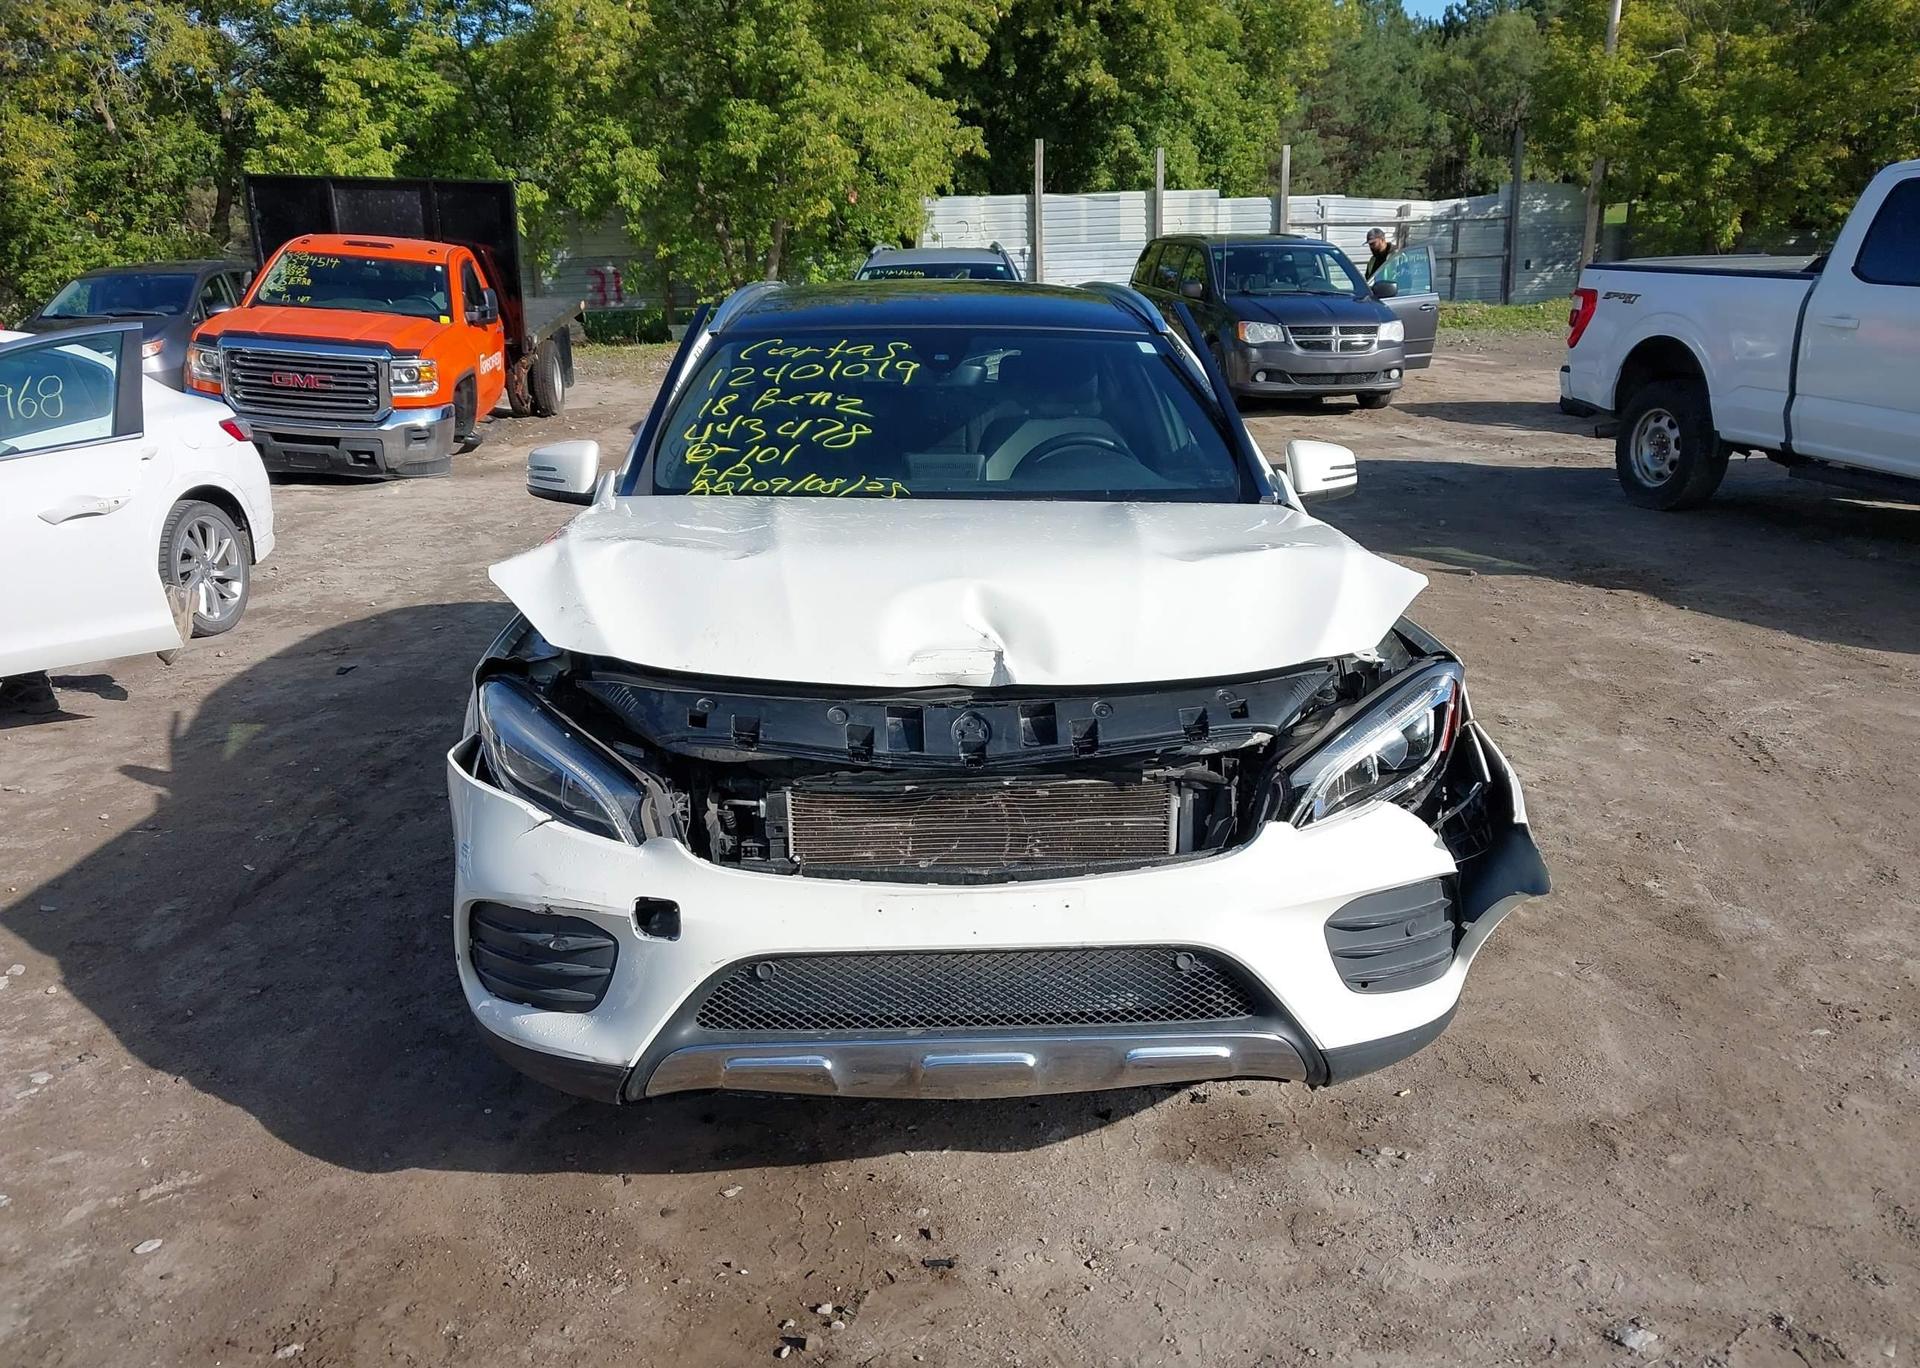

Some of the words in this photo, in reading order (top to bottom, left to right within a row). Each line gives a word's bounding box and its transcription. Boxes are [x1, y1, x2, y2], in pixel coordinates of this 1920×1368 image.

[1602, 291, 1643, 304] SPORT
[272, 371, 335, 389] GMC
[707, 359, 921, 391] 12401019
[698, 393, 739, 419] 18
[751, 388, 876, 418] Benz
